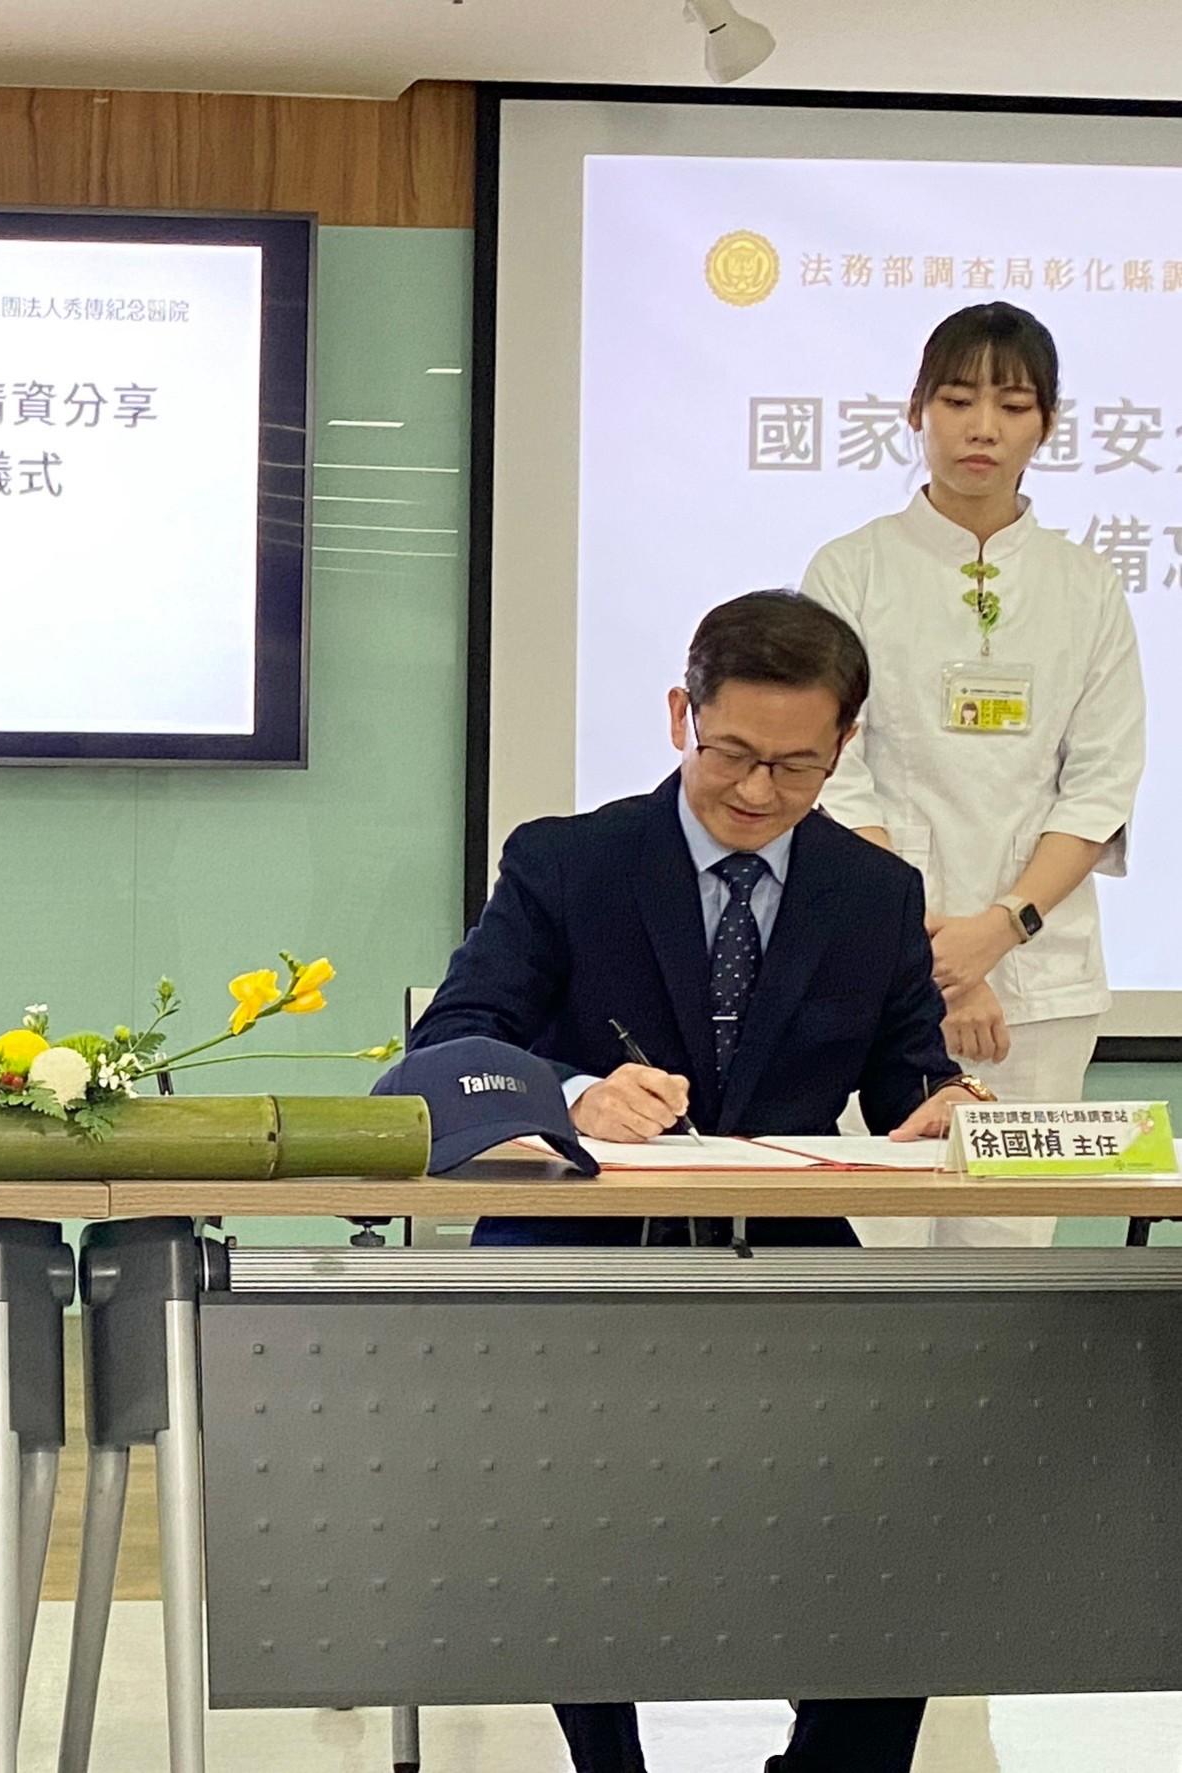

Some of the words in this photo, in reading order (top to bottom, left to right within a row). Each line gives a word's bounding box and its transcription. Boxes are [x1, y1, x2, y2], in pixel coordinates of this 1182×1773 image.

[458, 1073, 527, 1094] Taiwan
[970, 1129, 1065, 1158] 徐國楨
[1072, 1135, 1120, 1157] 主任
